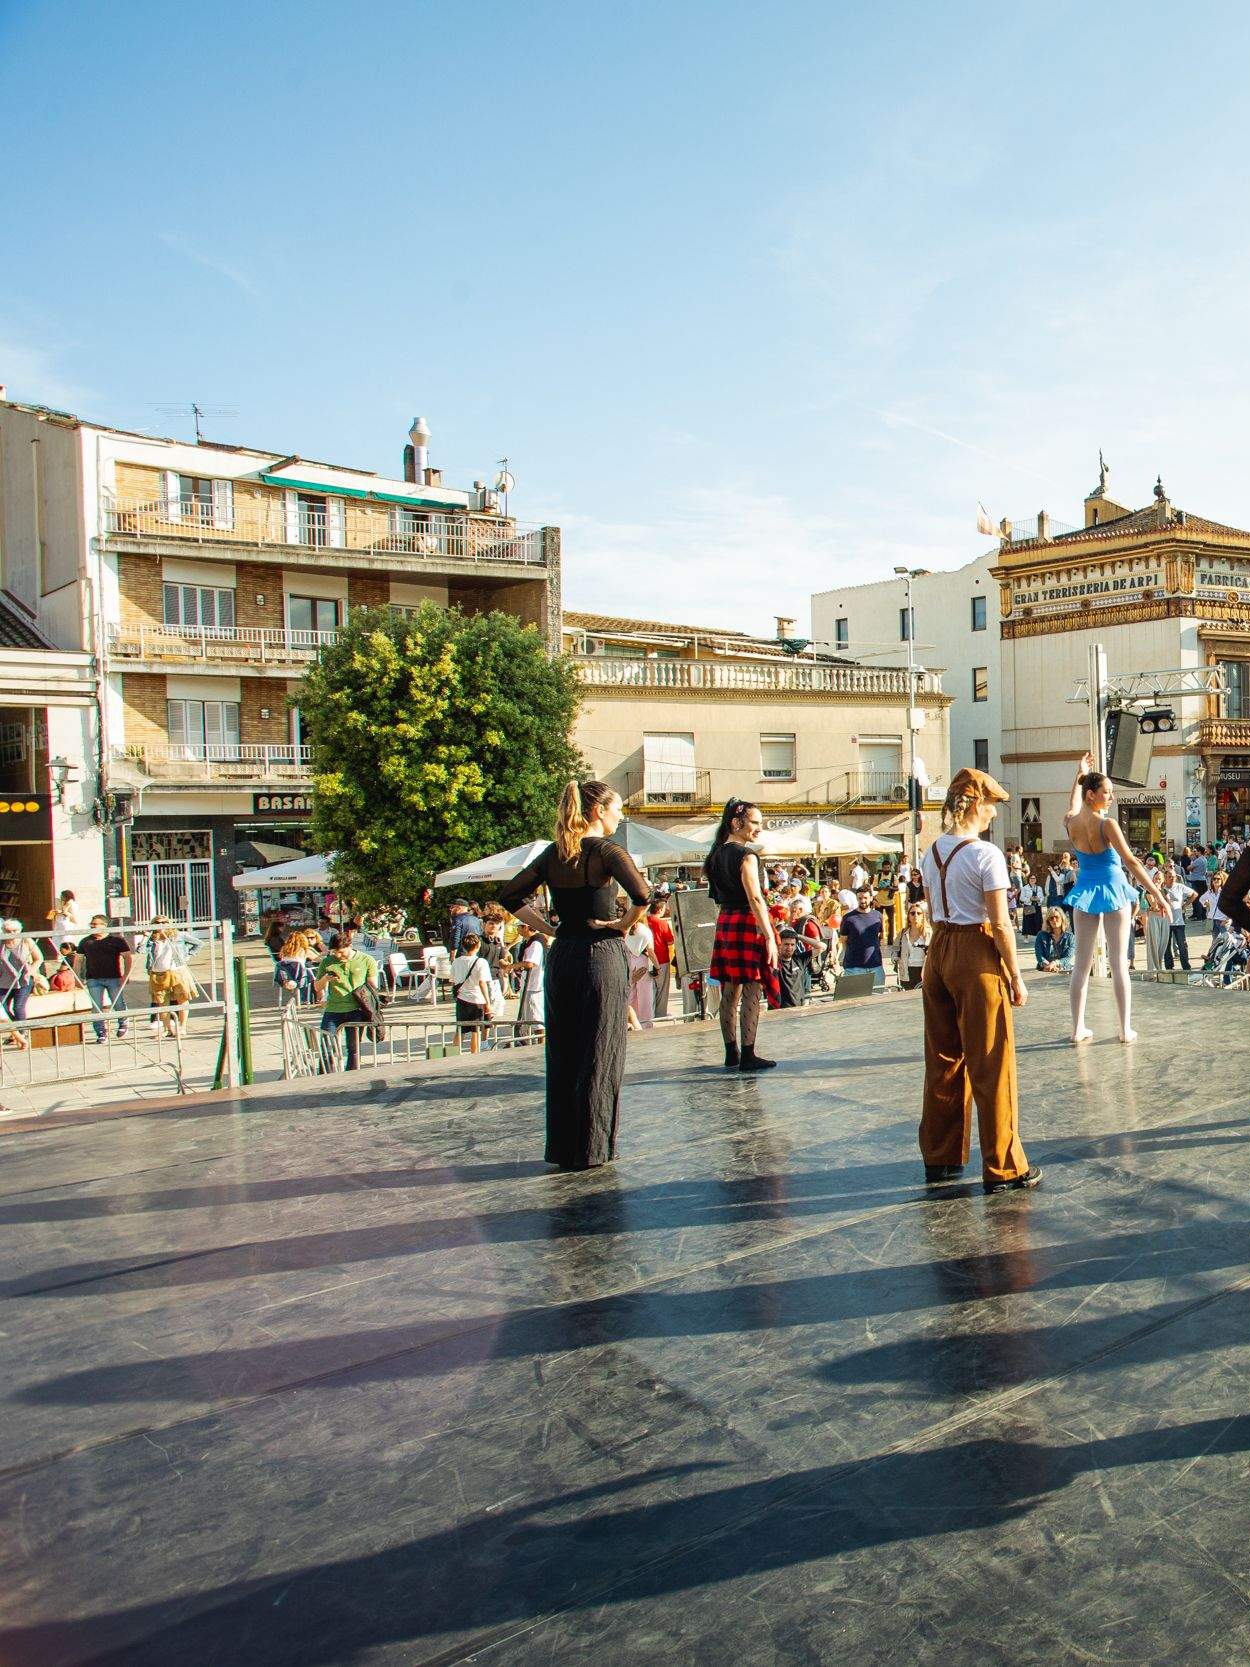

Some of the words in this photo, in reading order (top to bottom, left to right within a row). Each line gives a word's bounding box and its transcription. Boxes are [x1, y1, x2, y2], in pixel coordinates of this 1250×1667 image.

[1200, 573, 1248, 588] FABRICA
[1014, 591, 1039, 605] GRAN
[1041, 581, 1110, 600] TERRISSERIA
[1112, 578, 1127, 591] DE
